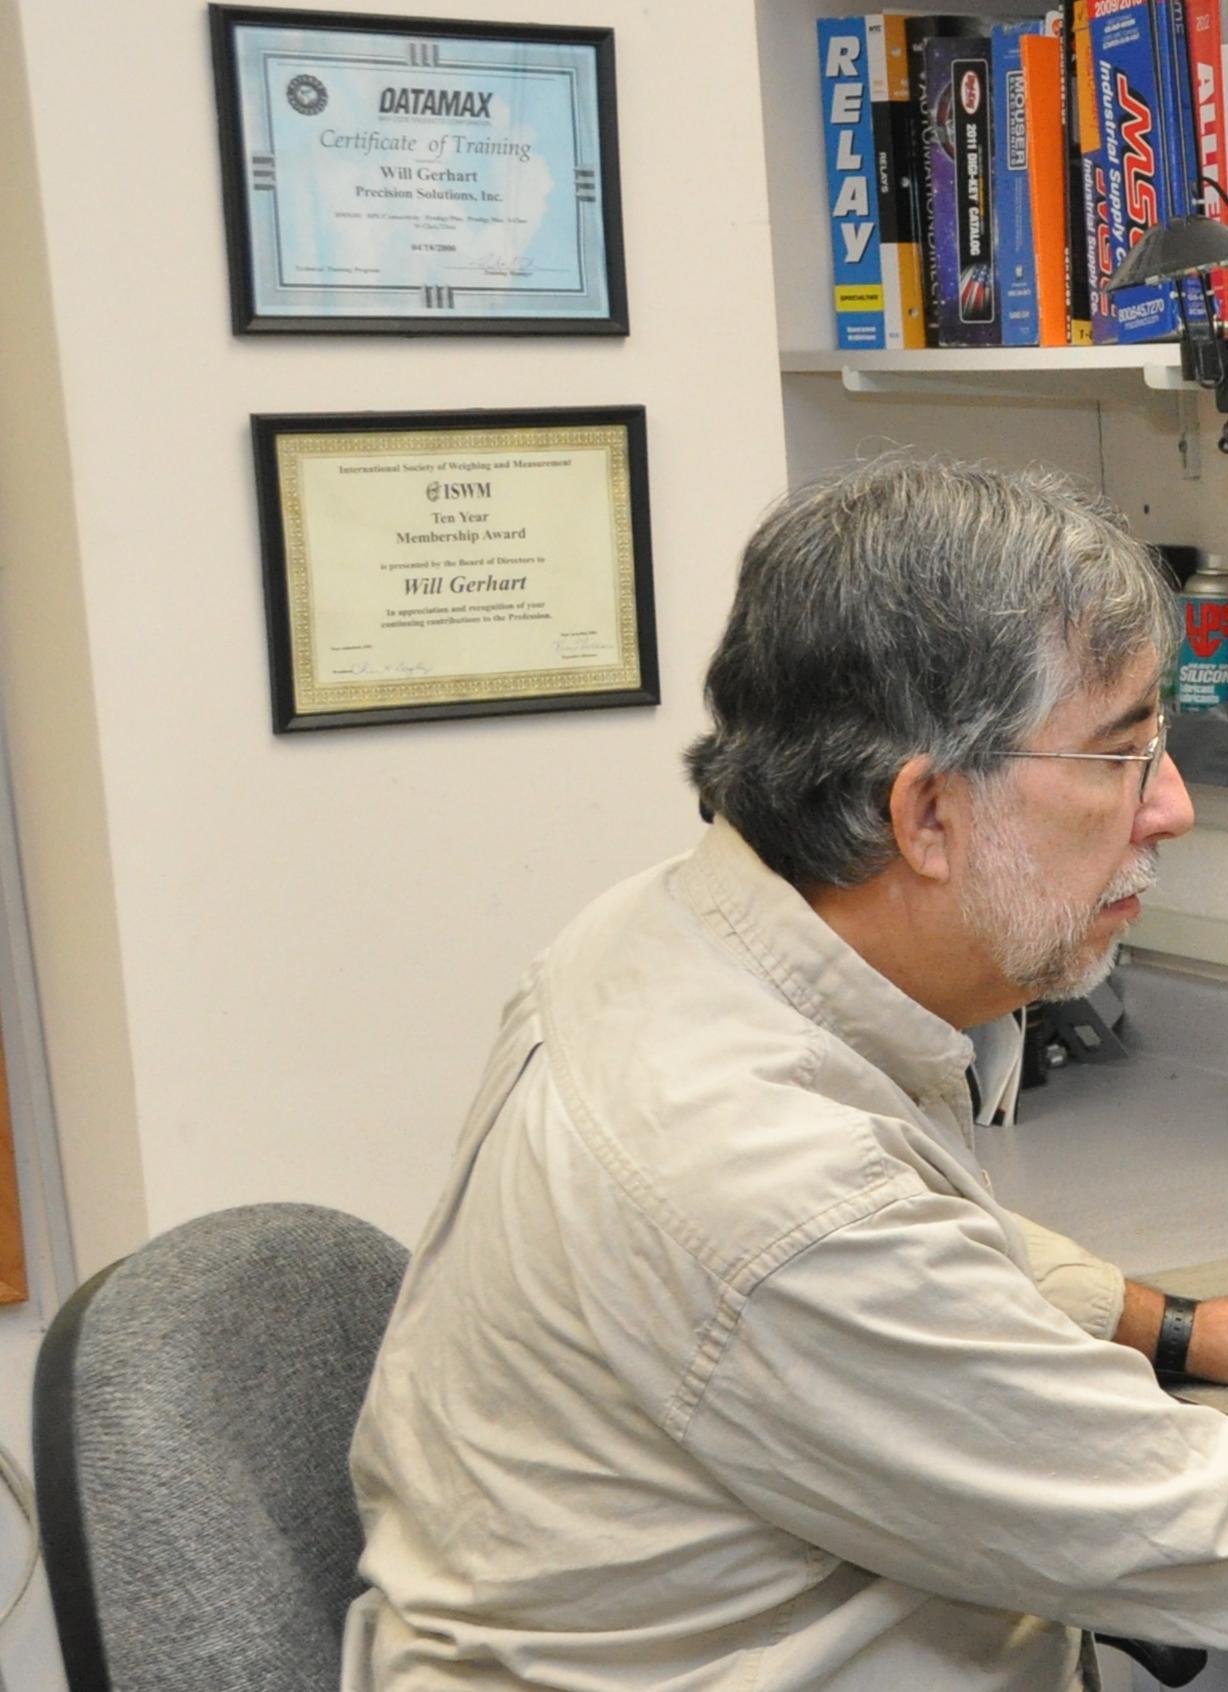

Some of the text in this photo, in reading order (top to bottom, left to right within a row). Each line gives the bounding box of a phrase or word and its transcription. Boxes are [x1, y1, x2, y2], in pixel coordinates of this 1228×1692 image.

[379, 87, 494, 119] DATAMAX
[1014, 75, 1025, 165] MOUSER
[1099, 60, 1119, 164] Industrial
[319, 129, 532, 163] Certificate of Training
[825, 35, 875, 264] RELAY
[966, 123, 978, 150] 2011
[380, 166, 478, 182] Will Gerhart
[879, 152, 889, 194] RELAYS
[967, 153, 980, 201] DIGI-KEY
[1116, 73, 1159, 249] MS
[355, 185, 413, 200] Precision
[481, 190, 504, 202] Inc.
[1083, 158, 1096, 234] Industrial
[1108, 168, 1126, 243] Supply
[968, 206, 981, 257] CATALOG
[1087, 237, 1098, 292] Supply
[339, 459, 573, 474] International Society of Weighing and Measurement
[443, 481, 492, 500] ISWM
[431, 511, 490, 525] Ten Year
[396, 528, 527, 545] Membership Award
[388, 560, 429, 572] presented
[404, 574, 528, 596] Will Gerhart
